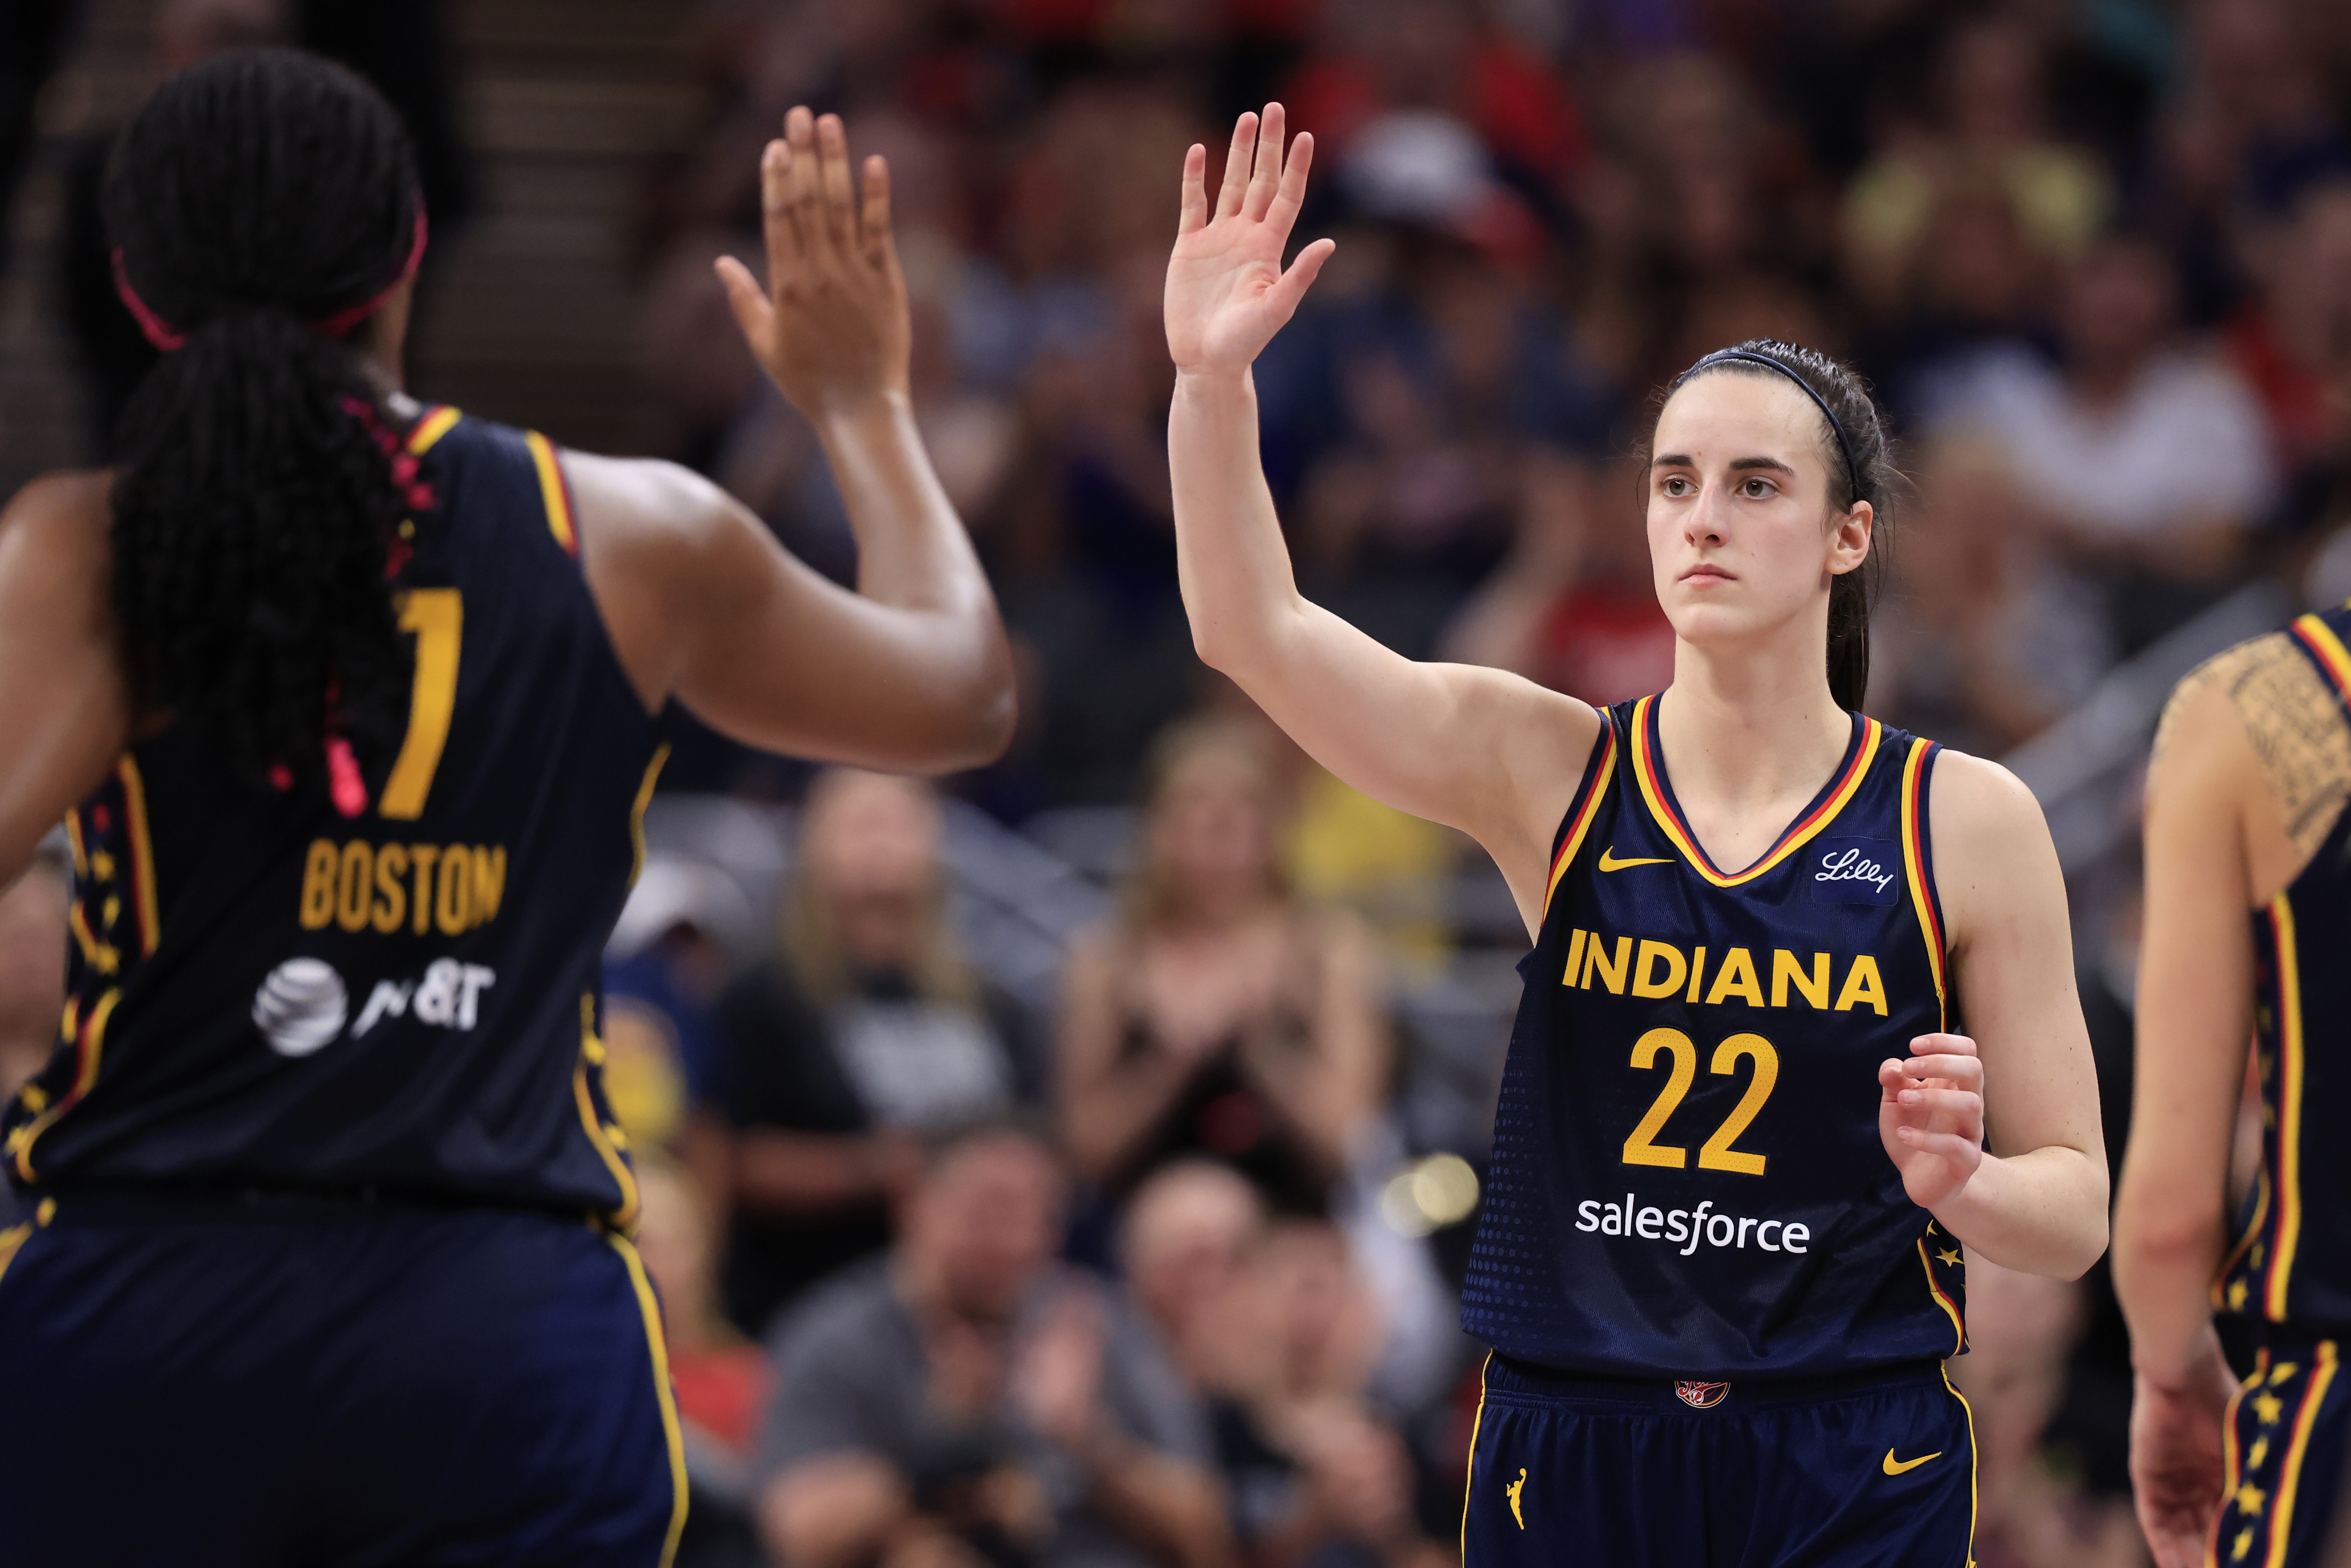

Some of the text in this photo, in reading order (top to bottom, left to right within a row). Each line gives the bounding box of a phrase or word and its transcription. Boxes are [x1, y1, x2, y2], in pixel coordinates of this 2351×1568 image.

[299, 838, 508, 936] BOSTON
[1814, 847, 1895, 895] Lilly
[1562, 928, 1888, 1017] INDIANA
[1622, 1027, 1779, 1176] 22
[1574, 1192, 1811, 1256] salesforce
